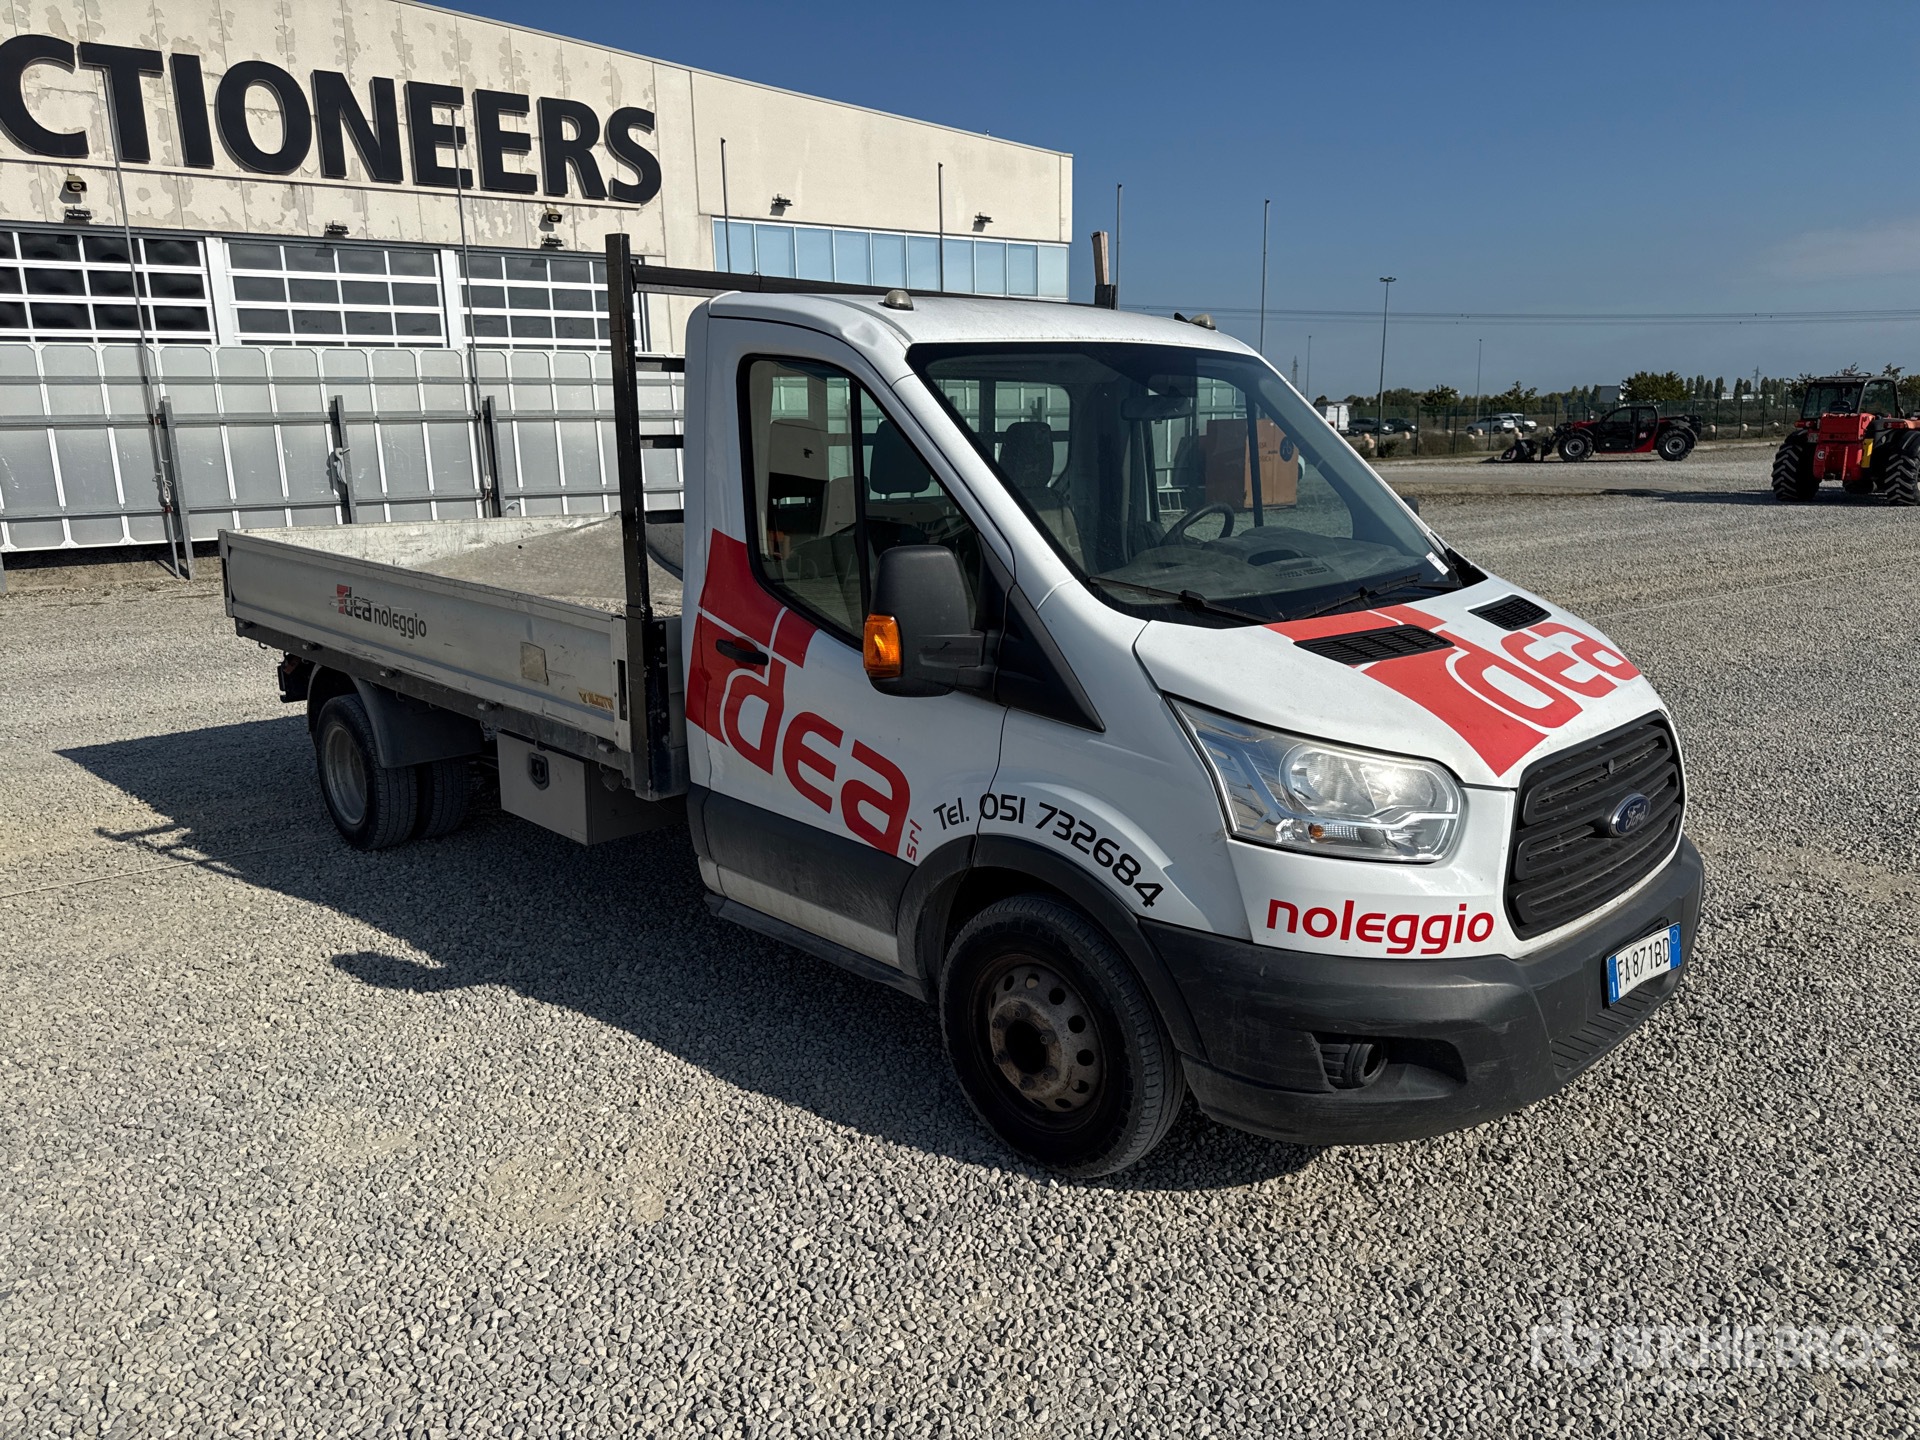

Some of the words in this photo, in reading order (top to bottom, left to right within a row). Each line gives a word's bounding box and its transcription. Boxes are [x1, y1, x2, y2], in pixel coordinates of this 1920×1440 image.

[0, 34, 662, 204] CTIONEERS
[374, 605, 427, 640] noleggio
[906, 818, 923, 862] srl
[1625, 803, 1647, 830] Ford
[933, 797, 970, 831] Tel.
[978, 793, 1026, 824] 051
[1034, 801, 1165, 908] 732684
[1266, 898, 1495, 955] noleggio
